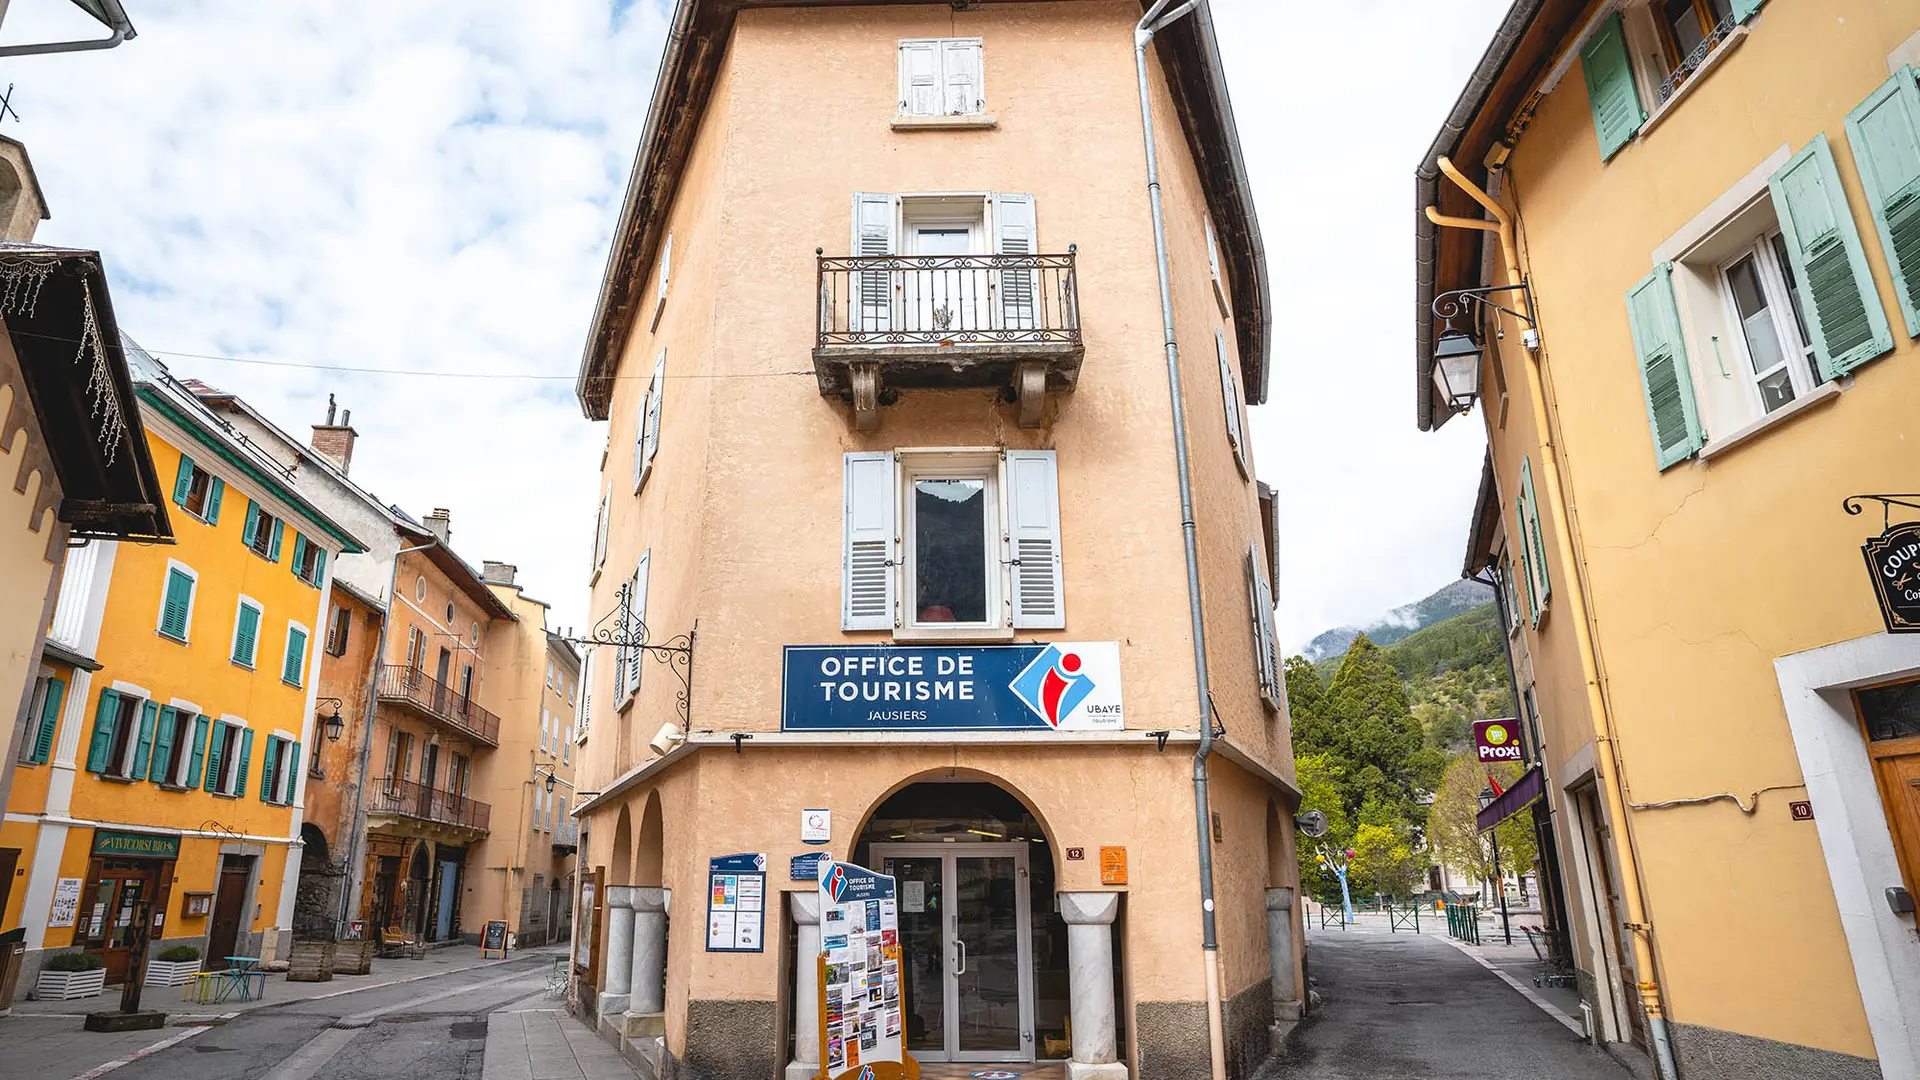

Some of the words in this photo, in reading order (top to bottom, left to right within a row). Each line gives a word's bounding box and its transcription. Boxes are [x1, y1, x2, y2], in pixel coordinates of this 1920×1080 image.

[1883, 543, 1920, 578] COUP
[821, 656, 923, 676] OFFICE
[937, 656, 973, 675] DE
[820, 681, 975, 701] TOURISME
[867, 710, 927, 721] JAUSIERS
[1087, 705, 1120, 713] UBAYE
[1479, 739, 1520, 758] Proxi
[1796, 805, 1806, 815] 10
[152, 840, 166, 852] BIO
